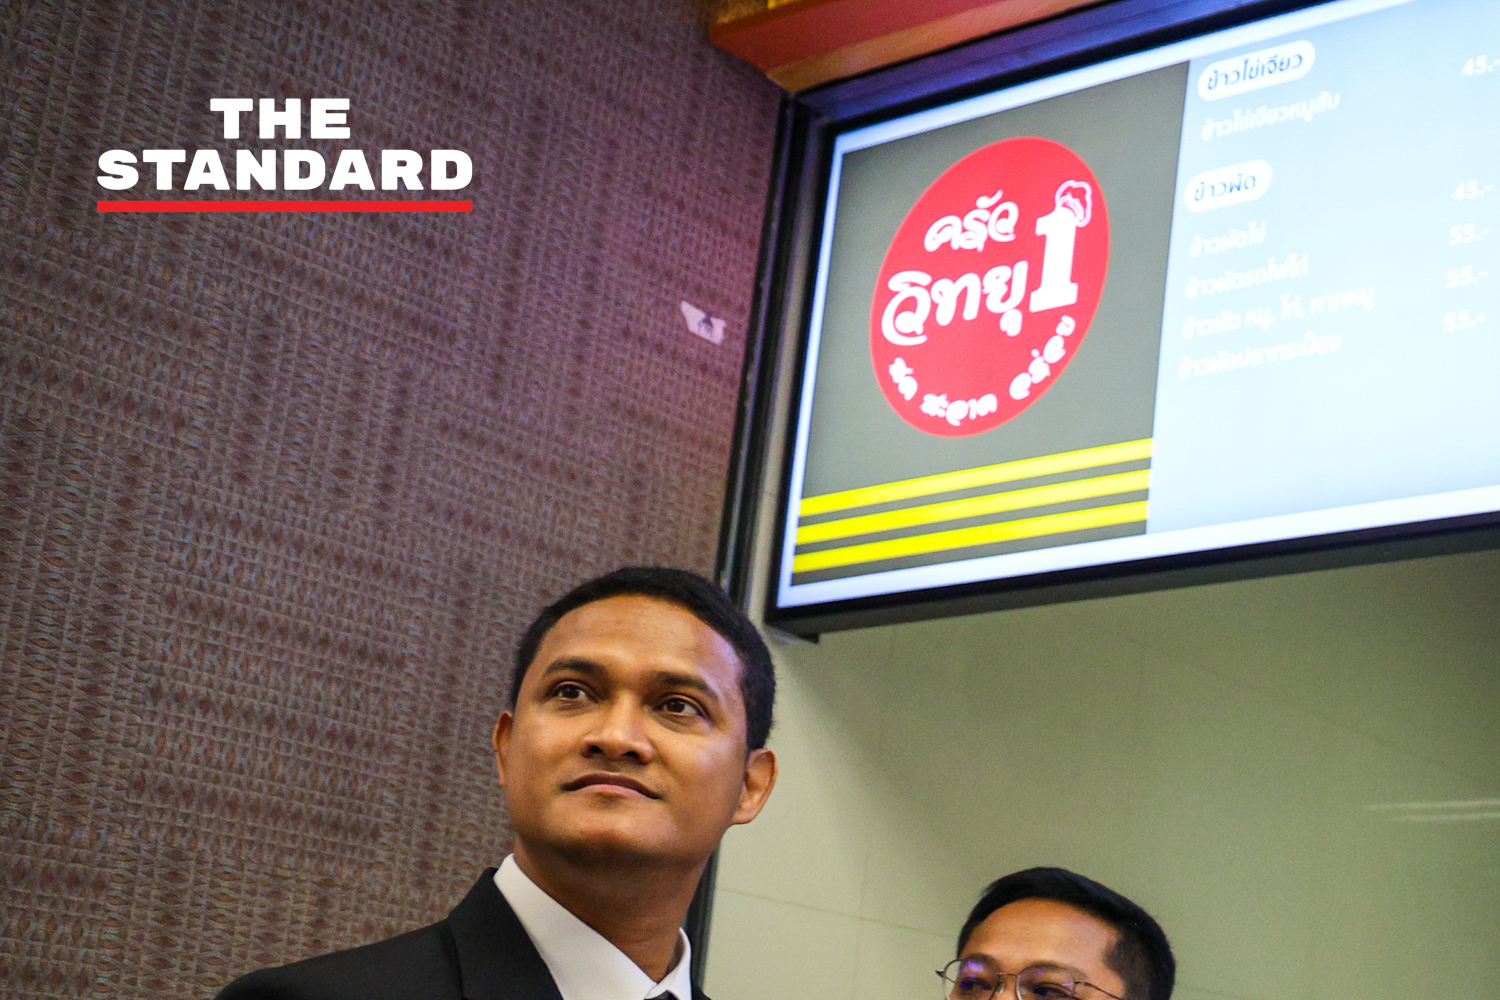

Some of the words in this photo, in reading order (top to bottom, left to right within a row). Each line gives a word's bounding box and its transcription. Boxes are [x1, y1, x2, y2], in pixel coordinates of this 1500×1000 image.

[1207, 52, 1304, 91] ข้าวไข่เจียว
[1194, 172, 1257, 202] ข้าวผัด
[1452, 179, 1494, 200] 45.-
[924, 189, 1019, 252] ครัว
[881, 260, 1028, 346] วิทยุ
[920, 393, 998, 426] สะอาด
[1009, 315, 1076, 400] อร่อย
